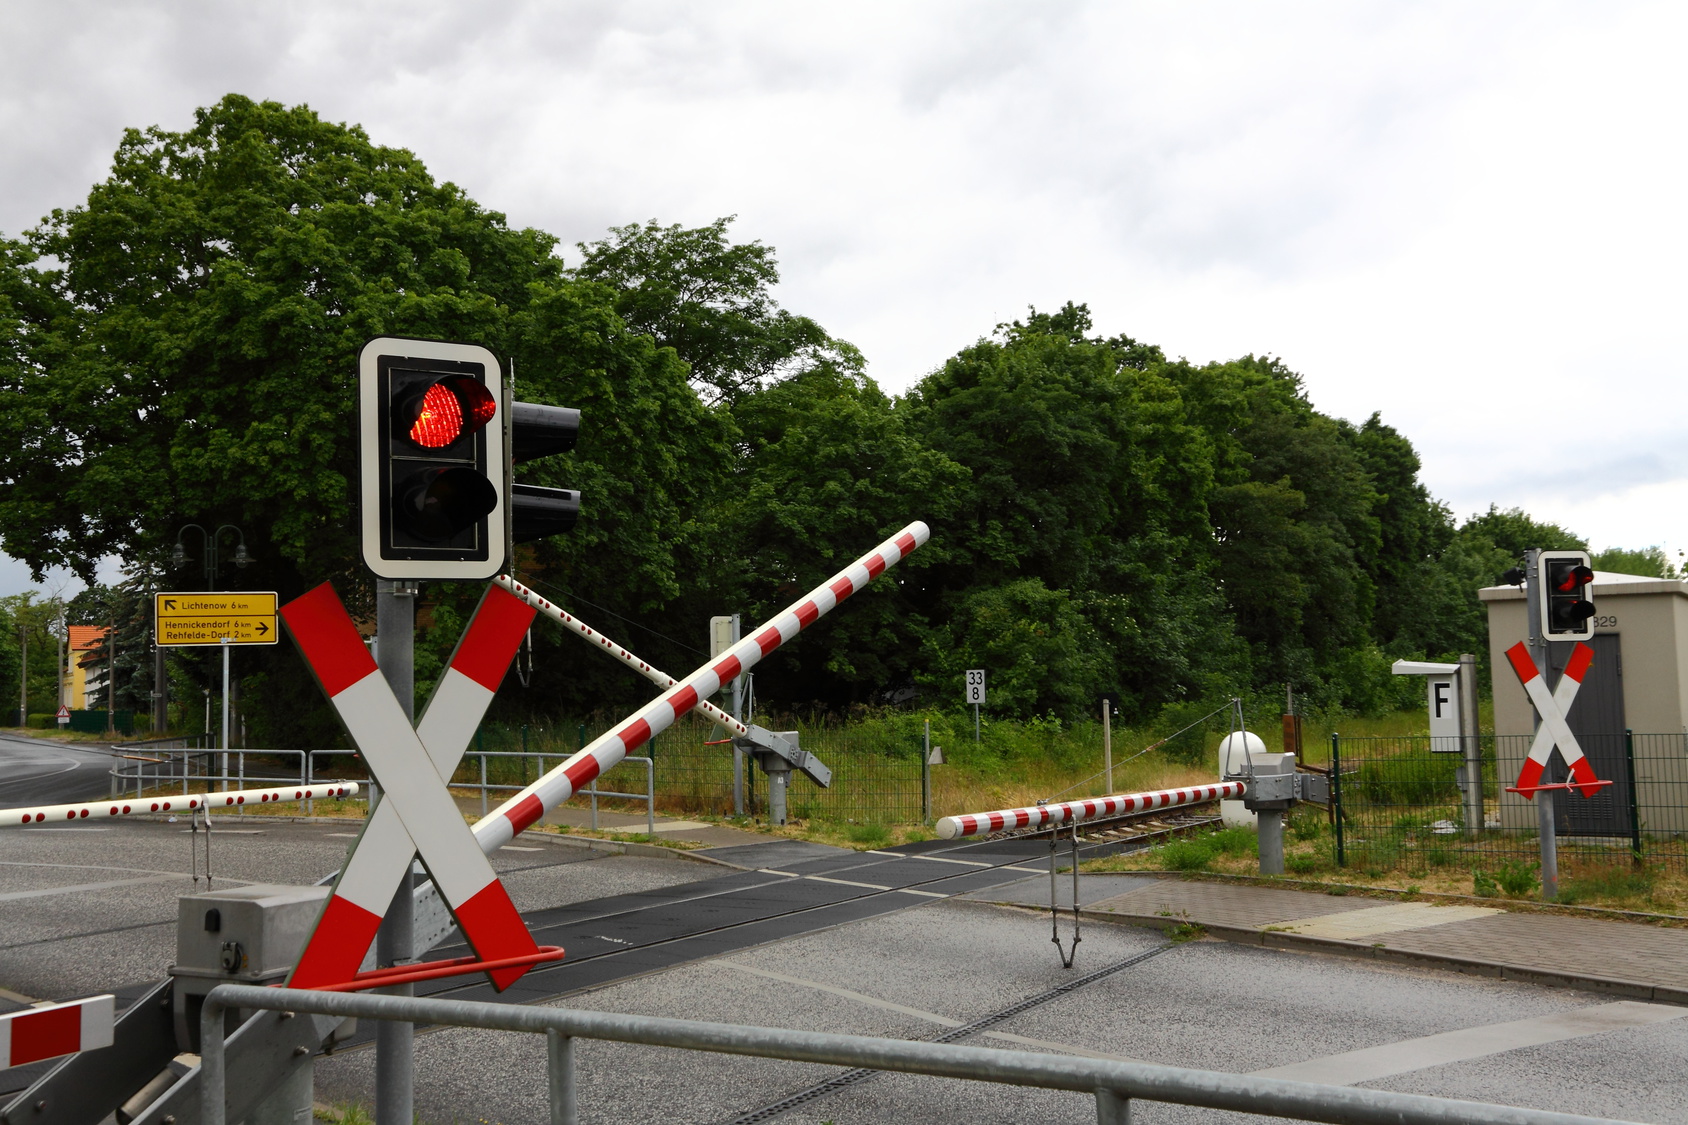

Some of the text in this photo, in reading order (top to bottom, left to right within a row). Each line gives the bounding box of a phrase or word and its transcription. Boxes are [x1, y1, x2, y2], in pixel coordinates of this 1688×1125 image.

[182, 602, 227, 610] Lichtenow
[165, 621, 230, 629] Hennickendorf
[166, 631, 230, 639] Rehfelde-Dorf
[968, 671, 983, 685] 33
[972, 687, 979, 700] 8
[1434, 683, 1450, 718] F
